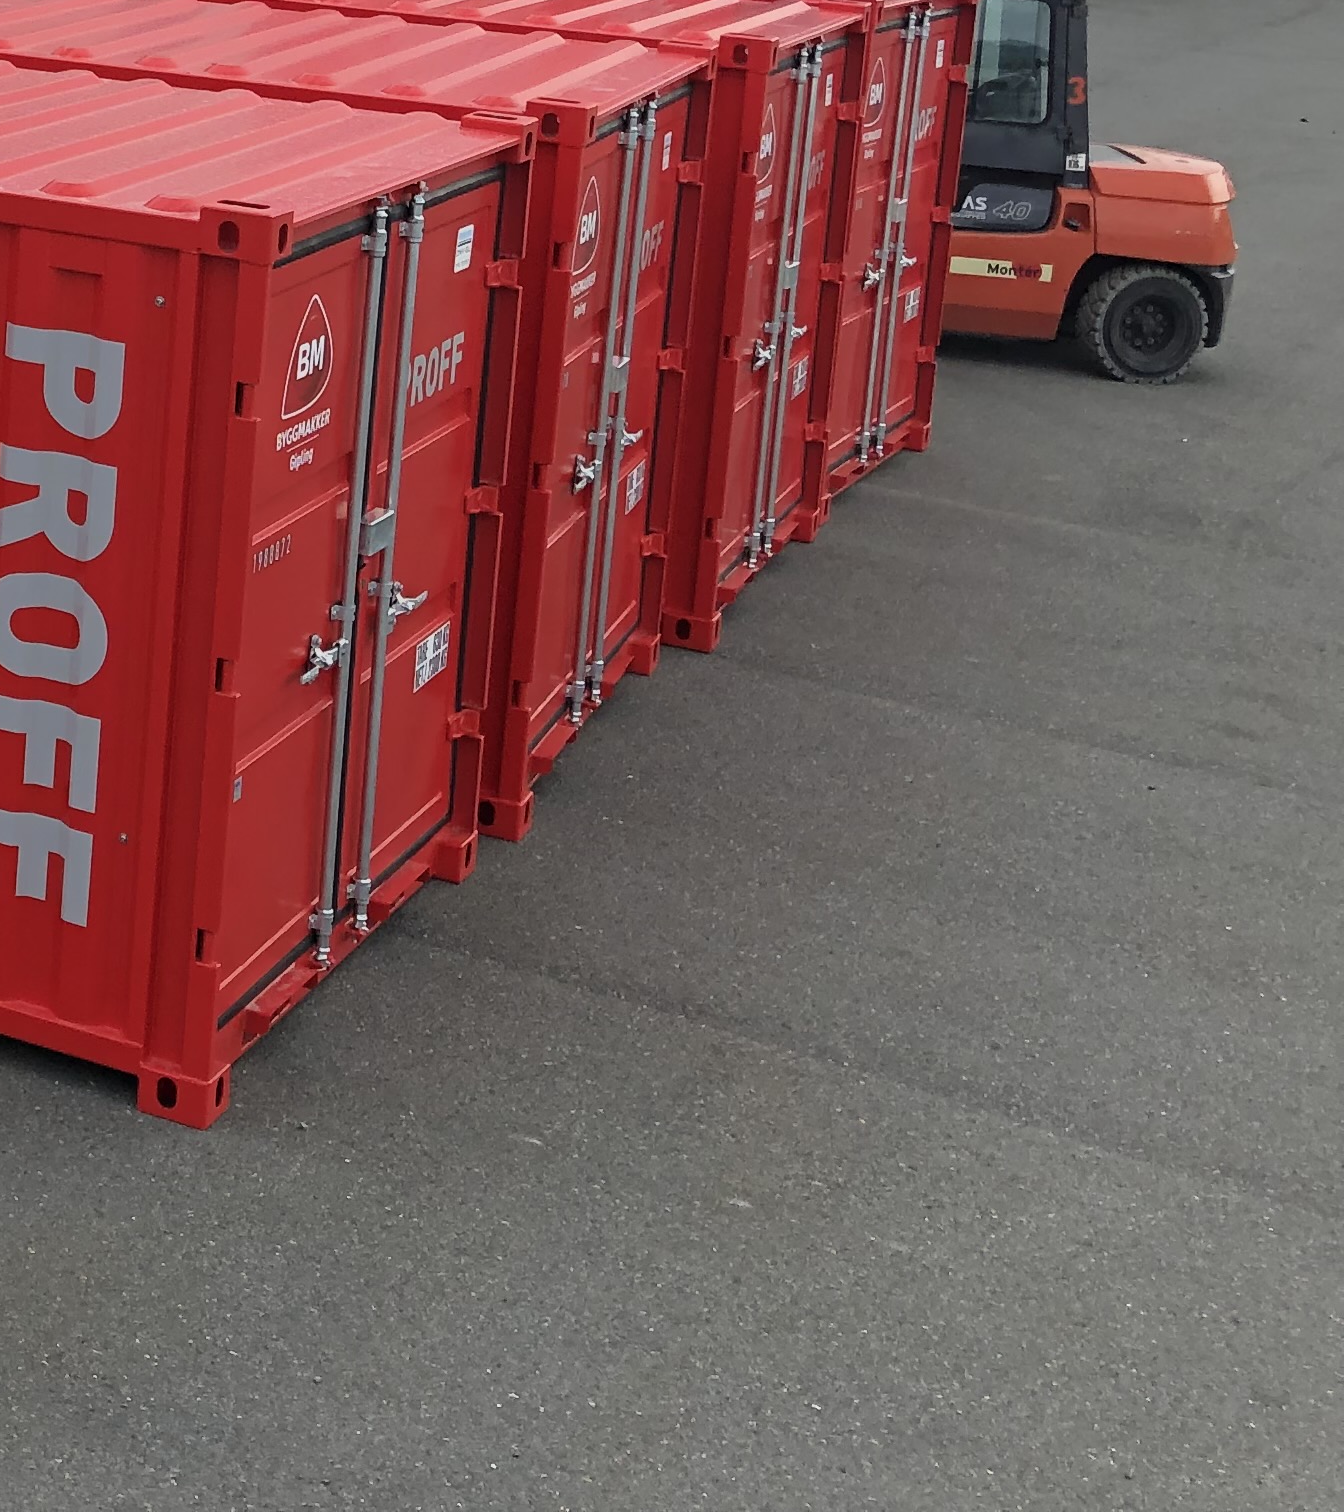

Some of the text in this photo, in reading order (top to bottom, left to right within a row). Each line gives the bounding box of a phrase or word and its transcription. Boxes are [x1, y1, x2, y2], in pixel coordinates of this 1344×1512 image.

[1067, 76, 1086, 105] 3
[579, 209, 597, 245] BM
[993, 200, 1032, 220] 40
[296, 335, 326, 381] BM
[406, 331, 465, 407] ROFF
[276, 407, 332, 452] BYGGMAKKER
